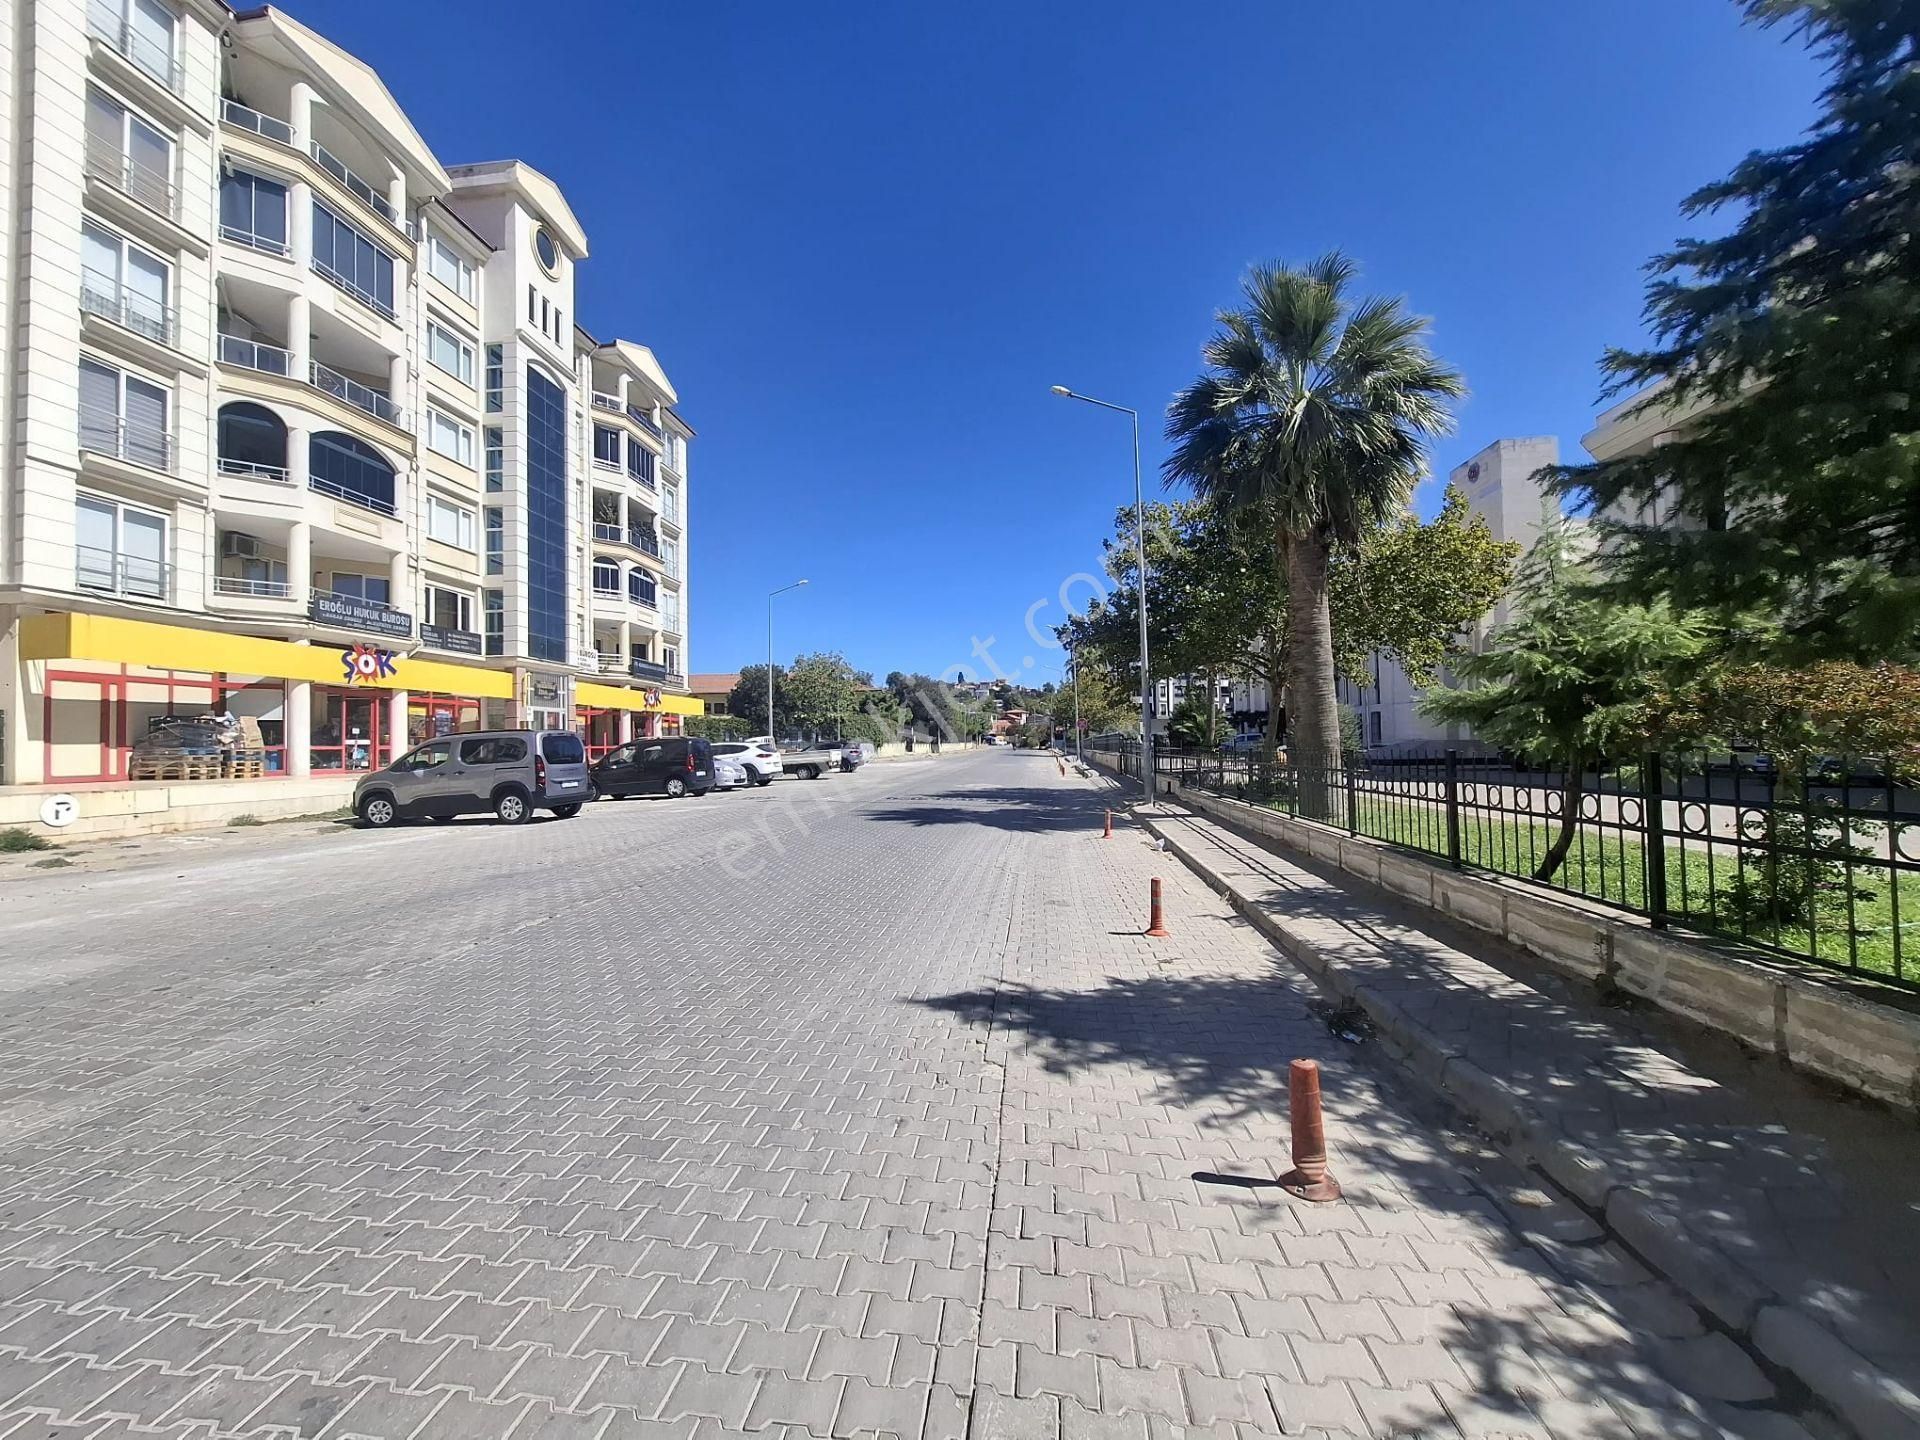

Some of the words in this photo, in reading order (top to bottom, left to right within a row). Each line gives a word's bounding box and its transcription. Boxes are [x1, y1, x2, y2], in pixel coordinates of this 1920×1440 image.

[319, 599, 352, 615] EROĞLU
[353, 606, 380, 621] HUKUK
[381, 611, 410, 627] BÜROSU
[341, 650, 398, 684] ŞOK
